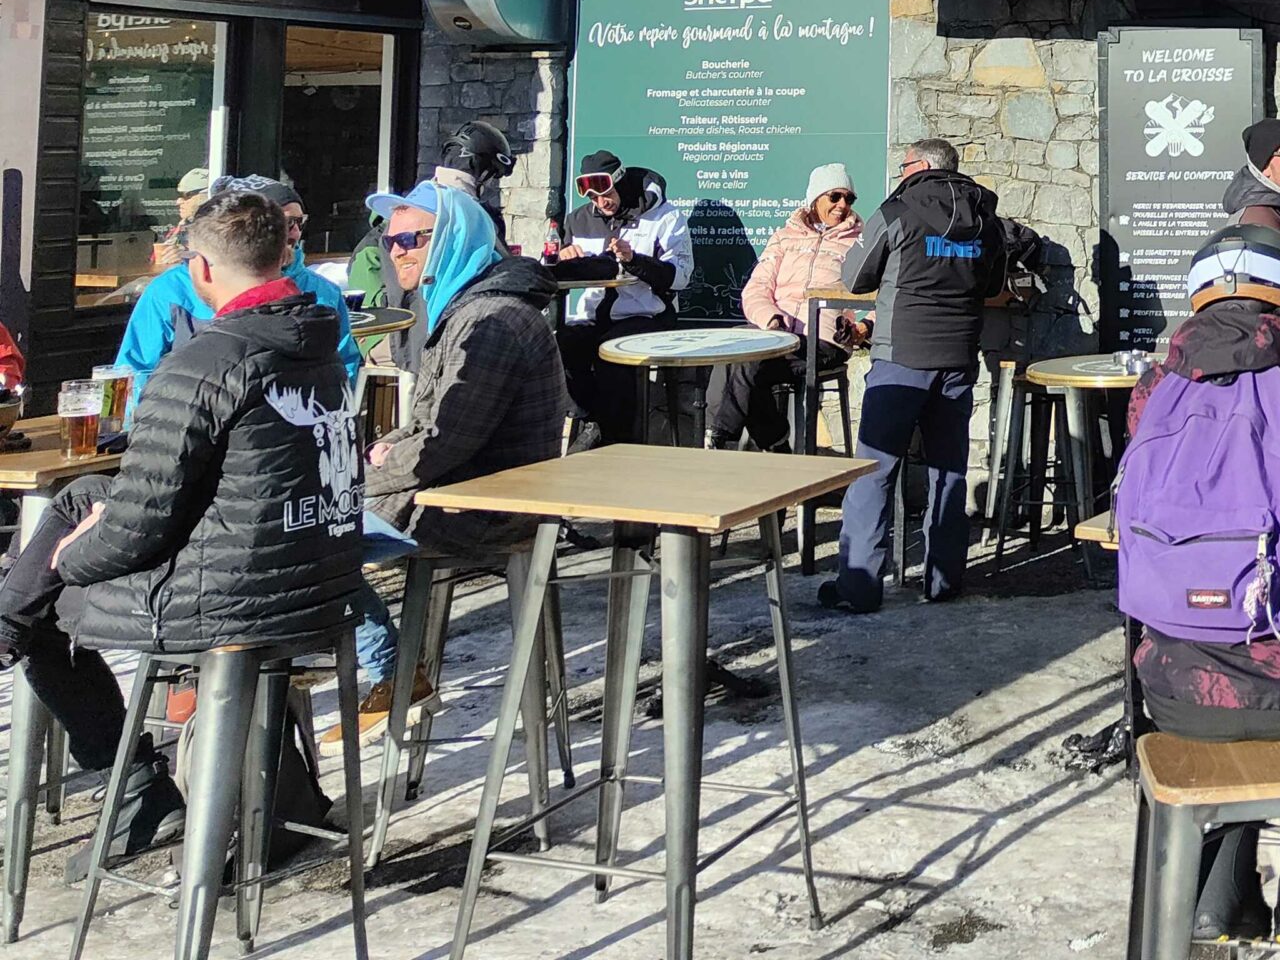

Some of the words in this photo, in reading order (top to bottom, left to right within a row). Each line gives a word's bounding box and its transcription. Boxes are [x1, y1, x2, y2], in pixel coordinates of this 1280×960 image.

[589, 22, 634, 47] Votre
[639, 22, 678, 47] repère
[682, 15, 752, 49] gourmand
[758, 21, 768, 38] à
[773, 15, 793, 39] la
[798, 17, 864, 44] montagne
[868, 17, 875, 37] !
[1142, 48, 1216, 64] WELCOME
[702, 60, 749, 69] Boucherie
[686, 70, 726, 79] Butcher's
[728, 70, 763, 79] counter
[1124, 69, 1144, 83] TO
[1148, 69, 1167, 82] LA
[1172, 67, 1233, 82] CROISSE
[647, 88, 687, 99] Fromage
[689, 88, 699, 97] et
[701, 87, 755, 96] charcuterie
[757, 87, 764, 96] à
[765, 87, 775, 96] la
[777, 88, 805, 99] coupe
[678, 98, 734, 107] Delicatessen
[736, 98, 771, 106] counter
[681, 116, 719, 125] Traiteur,
[721, 114, 767, 124] Rôtisserie
[649, 126, 704, 134] Home-made
[706, 125, 736, 135] dishes,
[739, 125, 762, 134] Roast
[765, 125, 801, 134] chicken
[678, 142, 716, 151] Produits
[719, 142, 769, 152] Régionaux
[683, 153, 721, 162] Regional
[724, 152, 764, 163] products
[697, 170, 719, 179] Cave
[721, 170, 727, 179] à
[729, 170, 748, 179] vins
[1126, 171, 1164, 181] SERVICE
[1167, 171, 1181, 181] AU
[1184, 170, 1233, 181] COMPTOIR
[698, 180, 719, 189] Wine
[722, 180, 747, 189] cellar
[668, 198, 707, 207] noiseries
[711, 198, 733, 207] cuits
[752, 198, 780, 209] place,
[783, 198, 810, 207] Sand
[682, 209, 704, 217] stries
[706, 209, 734, 217] baked
[737, 209, 771, 218] in-store,
[689, 226, 707, 235] reils
[710, 226, 715, 235] à
[718, 226, 753, 235] raclette
[716, 237, 733, 245] and
[736, 237, 768, 245] fondue
[926, 236, 983, 258] TIGNES
[284, 496, 316, 532] LE
[328, 523, 356, 538] Tignes
